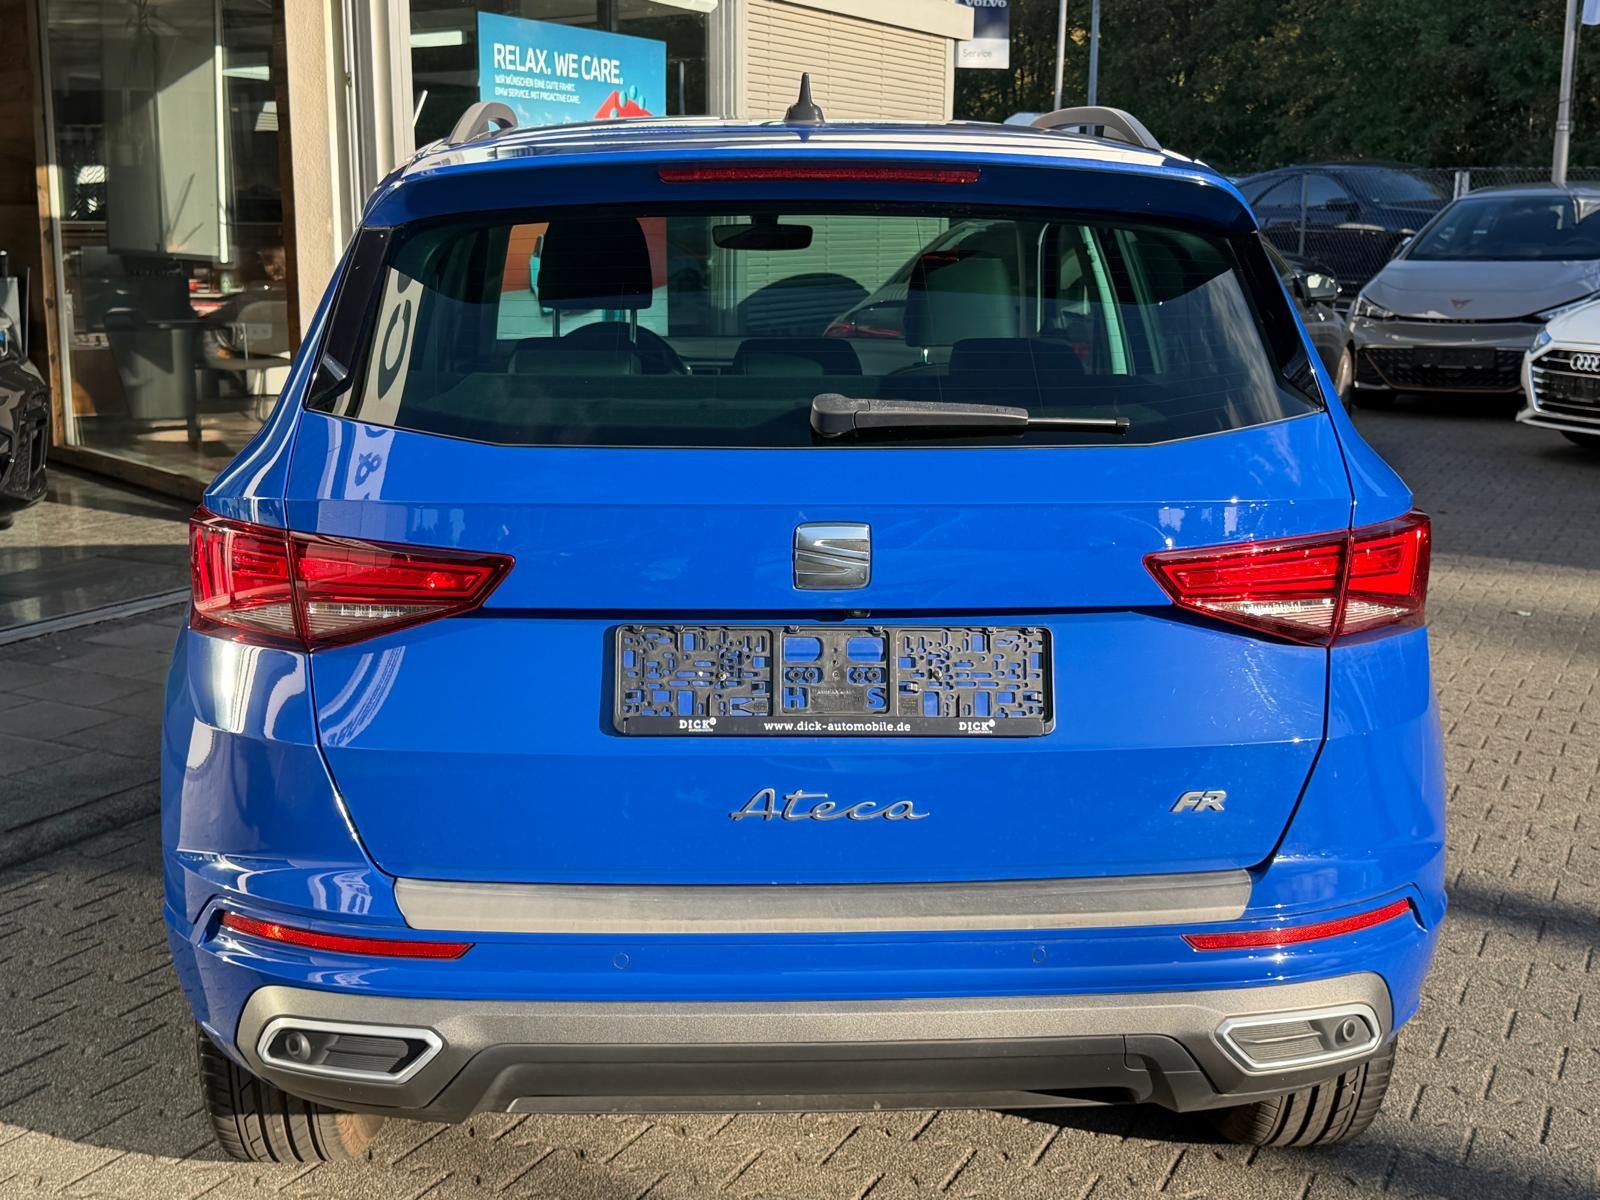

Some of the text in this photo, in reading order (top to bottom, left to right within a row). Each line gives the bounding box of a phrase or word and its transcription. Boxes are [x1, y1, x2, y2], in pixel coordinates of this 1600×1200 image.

[962, 48, 992, 58] Service
[493, 42, 624, 85] RELAX. WE CARE.
[679, 719, 710, 729] DICK
[763, 720, 911, 732] www.dick-automobile.de
[958, 721, 989, 731] DICK
[730, 787, 931, 821] Ateca
[1170, 790, 1227, 812] FR
